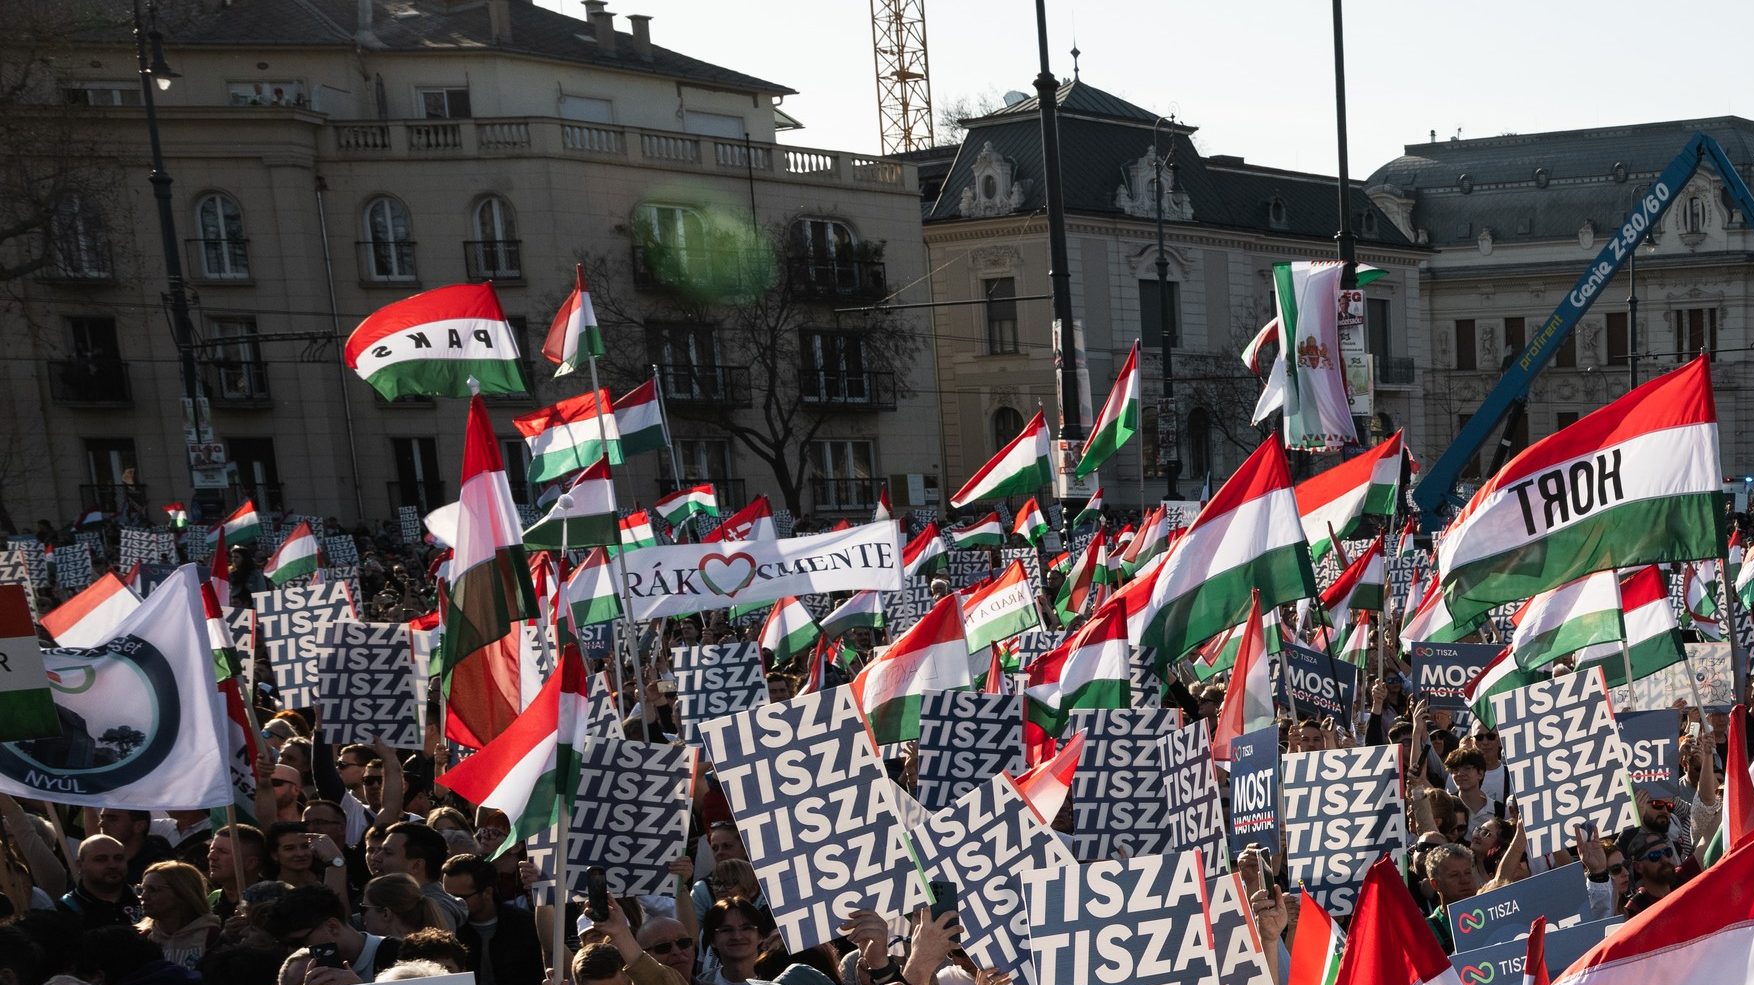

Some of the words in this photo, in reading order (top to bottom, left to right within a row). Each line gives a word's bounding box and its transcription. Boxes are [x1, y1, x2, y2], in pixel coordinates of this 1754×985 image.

[1570, 261, 1612, 307] Genie
[1609, 183, 1669, 261] Z-80/60
[1520, 314, 1563, 371] profirent
[949, 551, 990, 562] TISZA
[251, 580, 347, 614] TISZA
[314, 622, 412, 645] TISZA
[316, 647, 414, 670] TISZA
[671, 641, 761, 668] TISZA
[1437, 649, 1458, 657] TISZA
[318, 672, 416, 695] TISZA
[674, 666, 765, 692] TISZA
[1287, 671, 1348, 700] MOST
[319, 698, 418, 720] TISZA
[677, 690, 769, 717] TISZA
[920, 689, 1024, 720] TISZA
[1489, 670, 1606, 725] TISZA
[321, 723, 420, 745] TISZA
[700, 684, 866, 763] TISZA
[919, 719, 1024, 751] TISZA
[1073, 708, 1180, 736] TISZA
[1499, 701, 1616, 759] TISZA
[582, 737, 694, 773] TISZA
[1157, 723, 1210, 772] TISZA
[1282, 744, 1401, 784] TISZA
[1509, 735, 1622, 793] TISZA
[25, 769, 87, 794] NYÚL
[579, 767, 691, 802] TISZA
[719, 731, 880, 813] TISZA
[1164, 758, 1217, 809] TISZA
[1234, 768, 1274, 813] MOST
[1284, 778, 1401, 819] TISZA
[1517, 767, 1632, 828] TISZA
[575, 800, 687, 832] TISZA
[738, 777, 900, 863] TISZA
[1169, 799, 1224, 847] TISZA
[1234, 816, 1250, 834] VAGY
[1251, 811, 1275, 833] SOHA!
[1285, 812, 1405, 854] TISZA
[570, 832, 681, 865] TISZA
[757, 823, 915, 909] TISZA
[1022, 851, 1204, 924] TISZA
[775, 867, 933, 952] TISZA
[1488, 899, 1520, 920] TISZA
